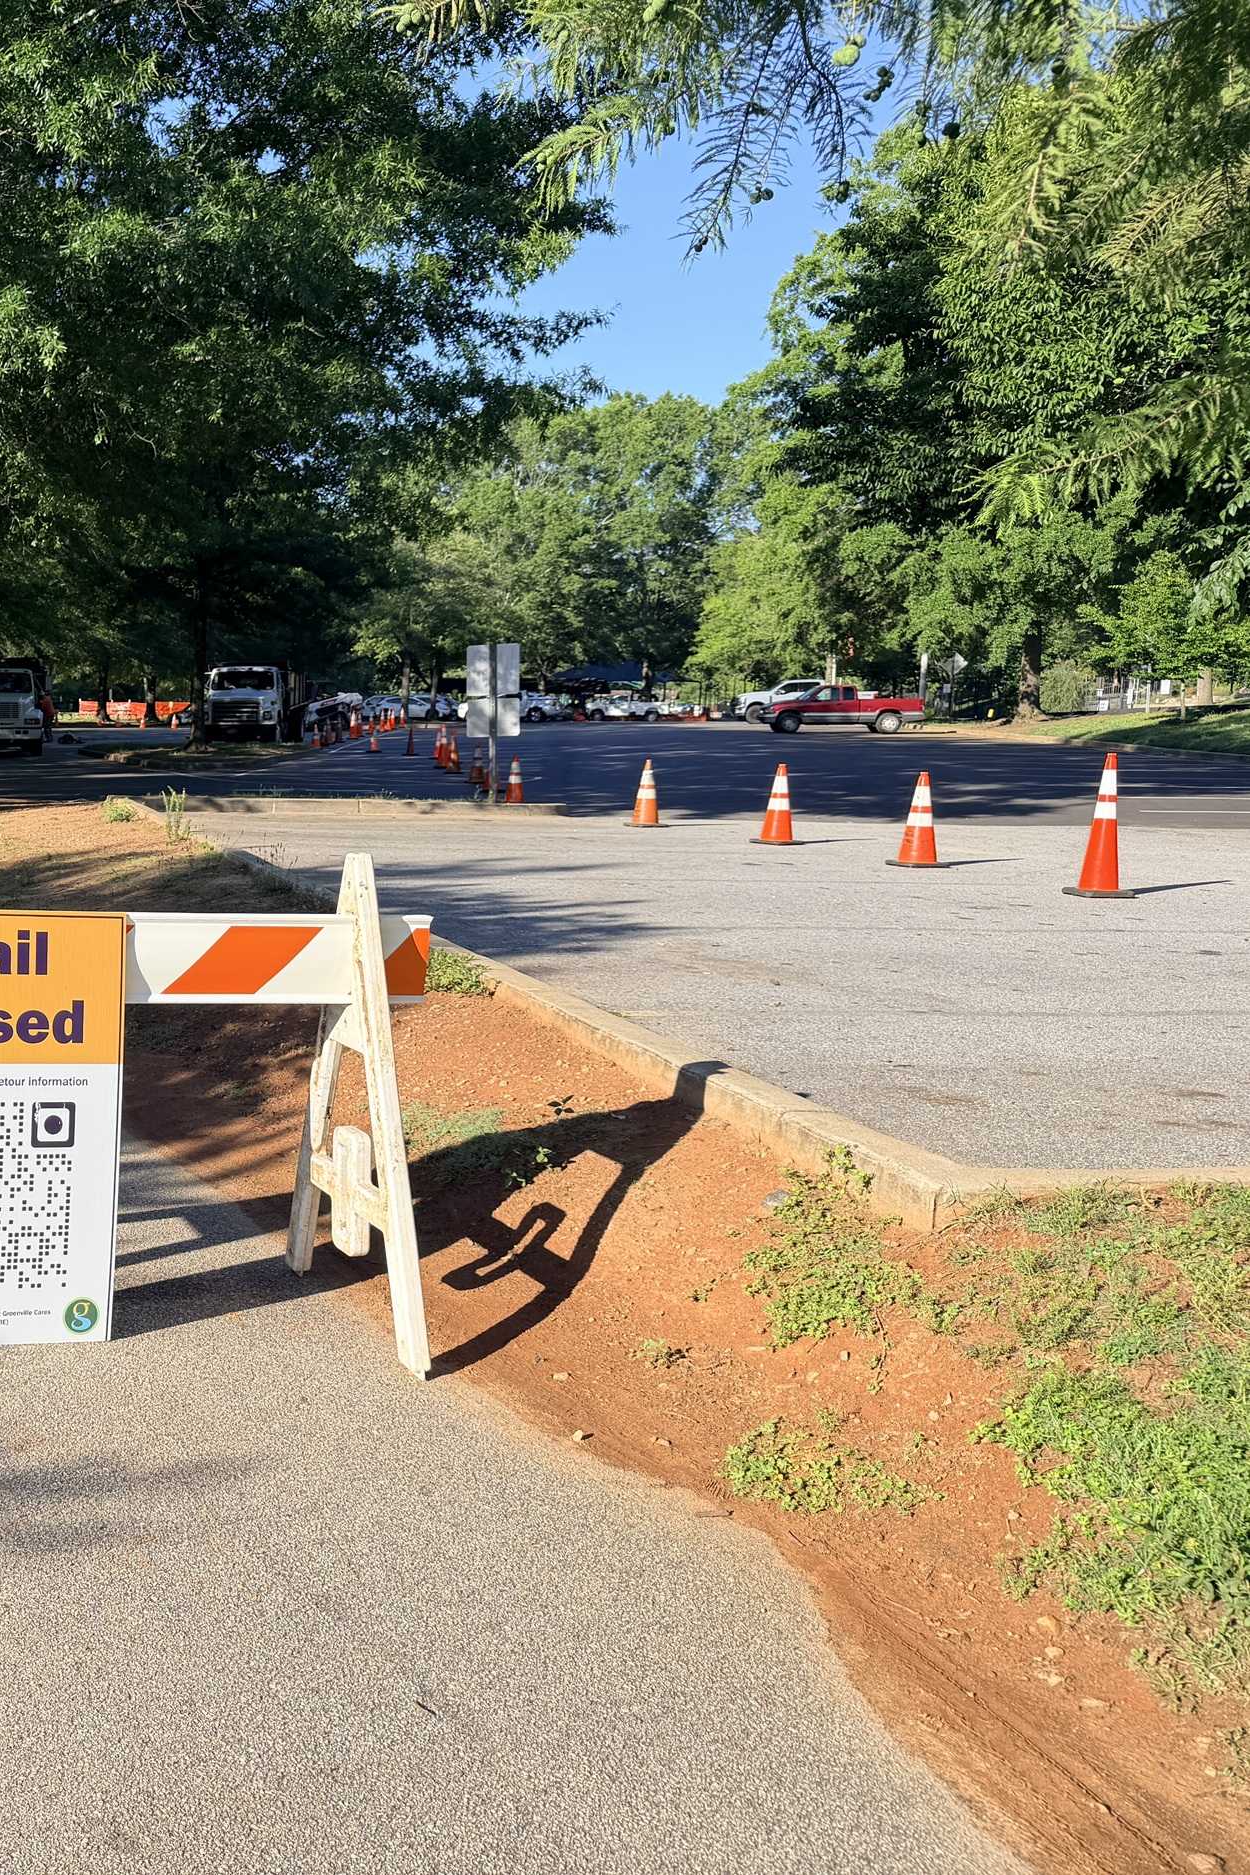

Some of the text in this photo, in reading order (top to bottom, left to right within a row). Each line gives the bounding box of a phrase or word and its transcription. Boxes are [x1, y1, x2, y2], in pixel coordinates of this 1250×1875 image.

[28, 1076, 89, 1087] information
[2, 1309, 33, 1317] Greenville
[33, 1308, 51, 1316] Cares
